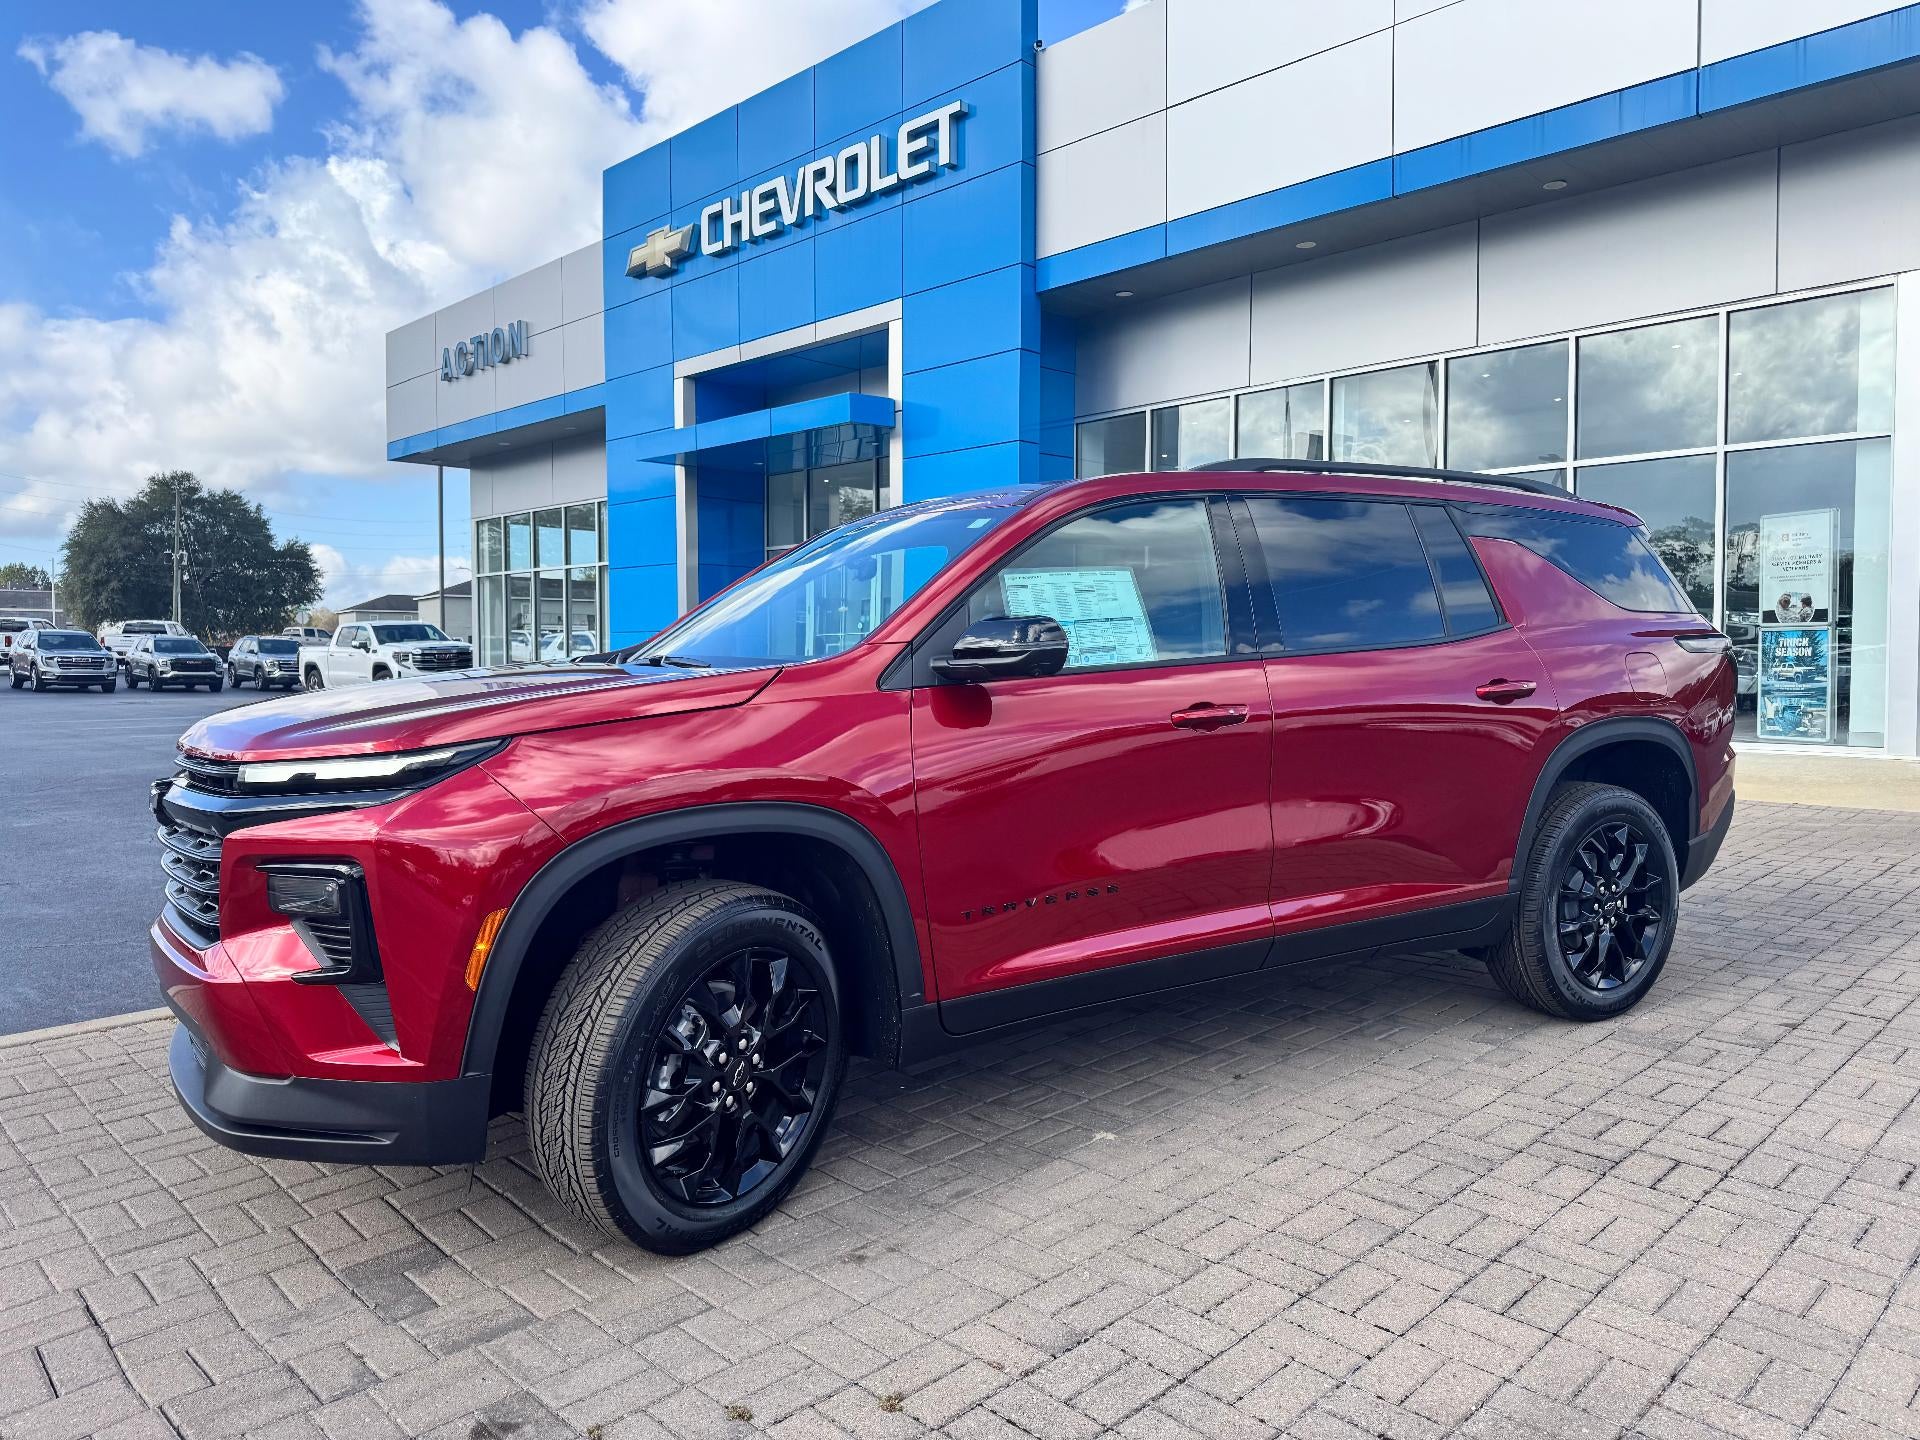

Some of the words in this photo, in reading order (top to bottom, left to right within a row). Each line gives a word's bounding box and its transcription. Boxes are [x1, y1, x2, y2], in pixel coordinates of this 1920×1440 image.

[700, 99, 968, 257] CHEVROLET
[441, 320, 528, 382] ACTION
[1775, 647, 1813, 657] SEASON
[1778, 637, 1810, 647] TRUCK
[961, 884, 1119, 920] TRAVERSE
